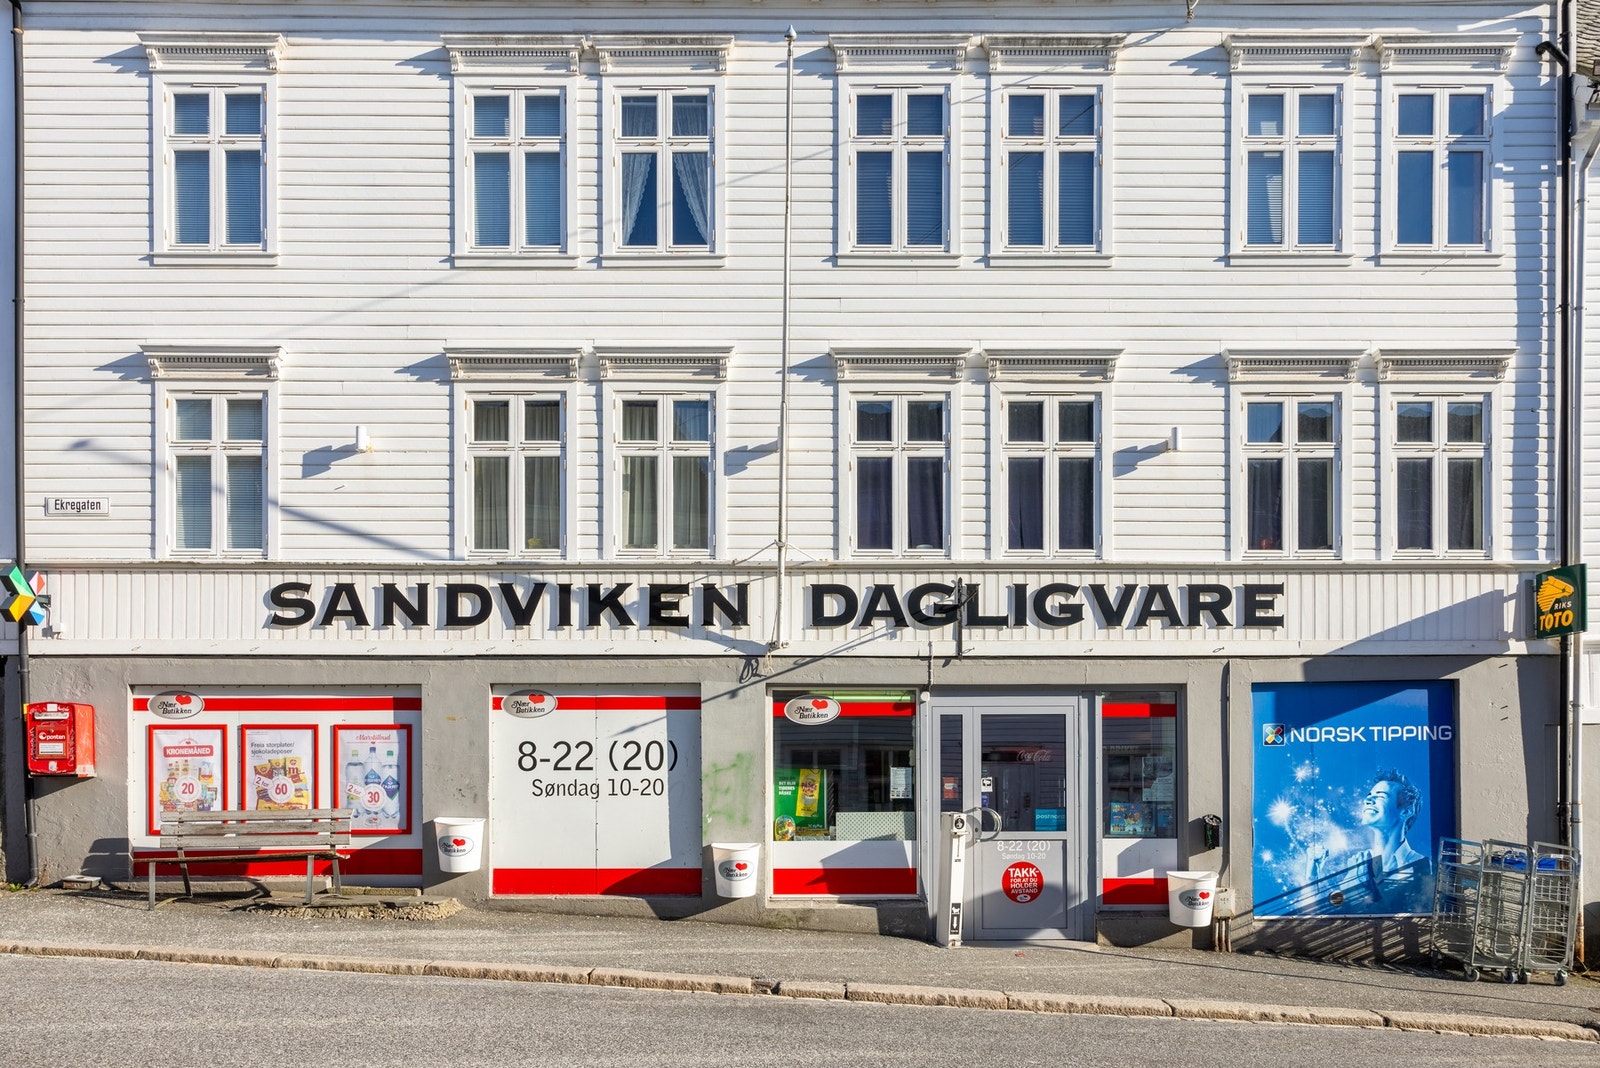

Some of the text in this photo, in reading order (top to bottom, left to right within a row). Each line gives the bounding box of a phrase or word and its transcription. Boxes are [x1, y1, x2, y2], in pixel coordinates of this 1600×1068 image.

[54, 499, 101, 512] Ekregaten
[269, 582, 1285, 628] SANDVIKEN DAGLIGVARE
[1554, 601, 1572, 610] RIKS
[1539, 609, 1574, 631] TOTO
[157, 701, 178, 709] Nær
[511, 700, 530, 708] Nær
[161, 707, 192, 715] Butikken
[794, 706, 813, 714] Nær
[1290, 725, 1452, 742] NORSK TIPPING
[166, 746, 211, 755] KRONEMÅNED
[517, 739, 678, 772] 8-22 (20)
[255, 776, 262, 785] 2
[181, 783, 195, 794] 20
[275, 783, 288, 795] 60
[347, 784, 354, 793] 2
[532, 778, 664, 799] Søndag 10-20
[367, 791, 380, 803] 30
[997, 840, 1051, 851] 8-22 (20)
[1001, 852, 1047, 860] Søndag 10-20
